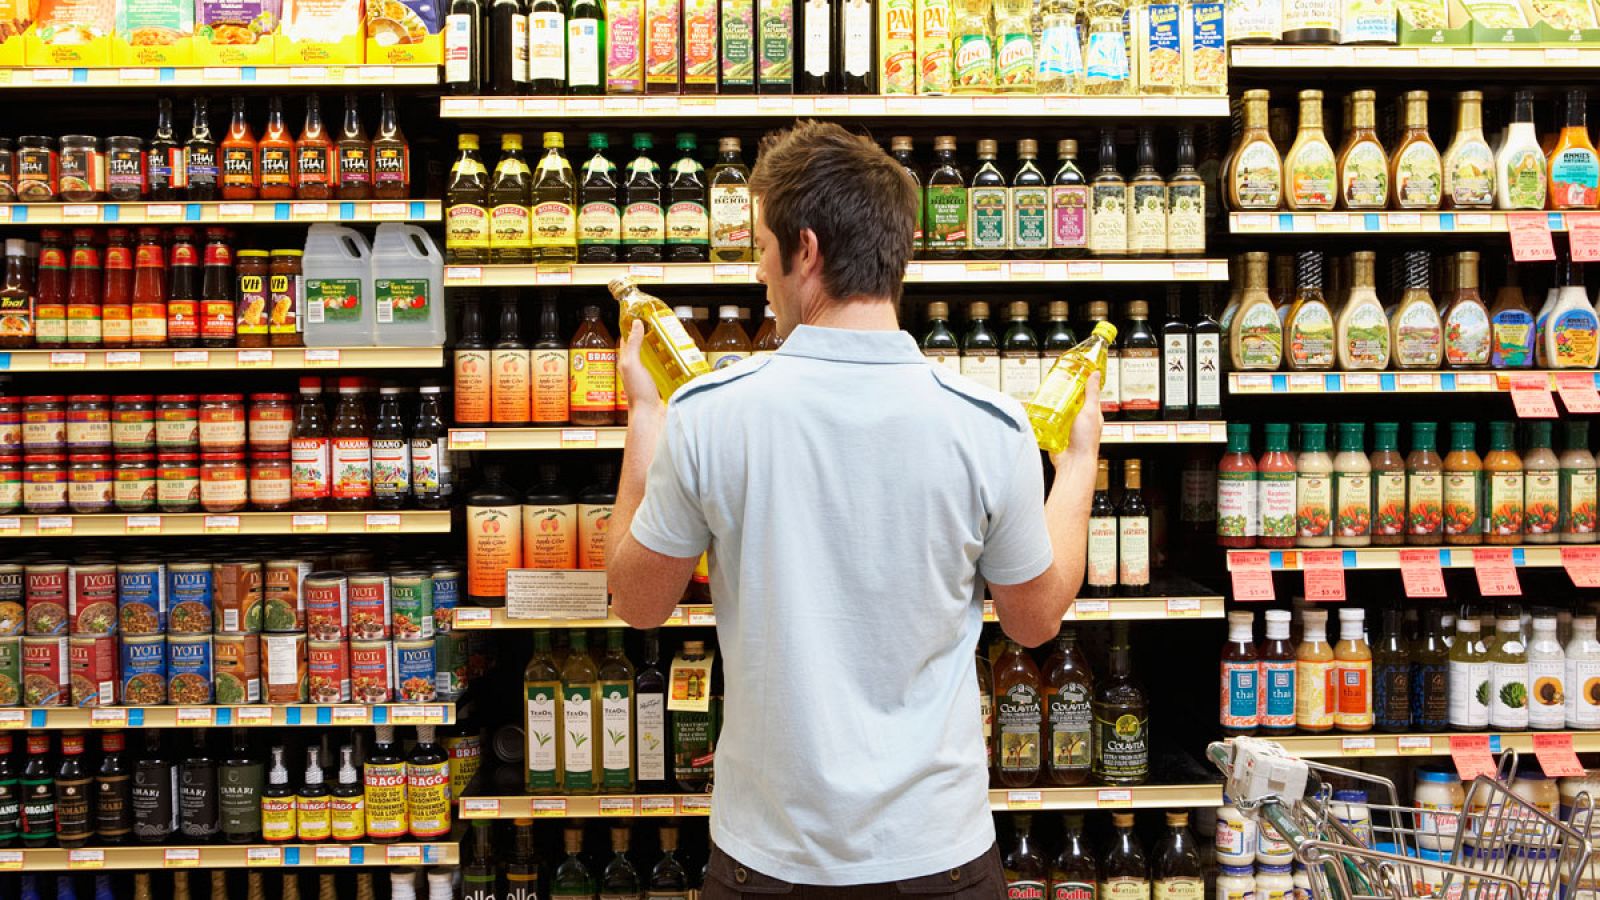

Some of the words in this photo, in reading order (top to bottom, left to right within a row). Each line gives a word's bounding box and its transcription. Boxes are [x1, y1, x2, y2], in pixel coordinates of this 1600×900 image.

[924, 8, 945, 31] PA
[111, 159, 138, 173] THAI
[225, 159, 252, 172] THAI
[261, 159, 289, 172] THAI
[298, 159, 325, 170] THAI
[342, 158, 369, 170] THAI
[376, 158, 402, 170] THAI
[2, 297, 24, 307] Thai
[1235, 690, 1254, 700] thai
[1273, 689, 1291, 699] thai
